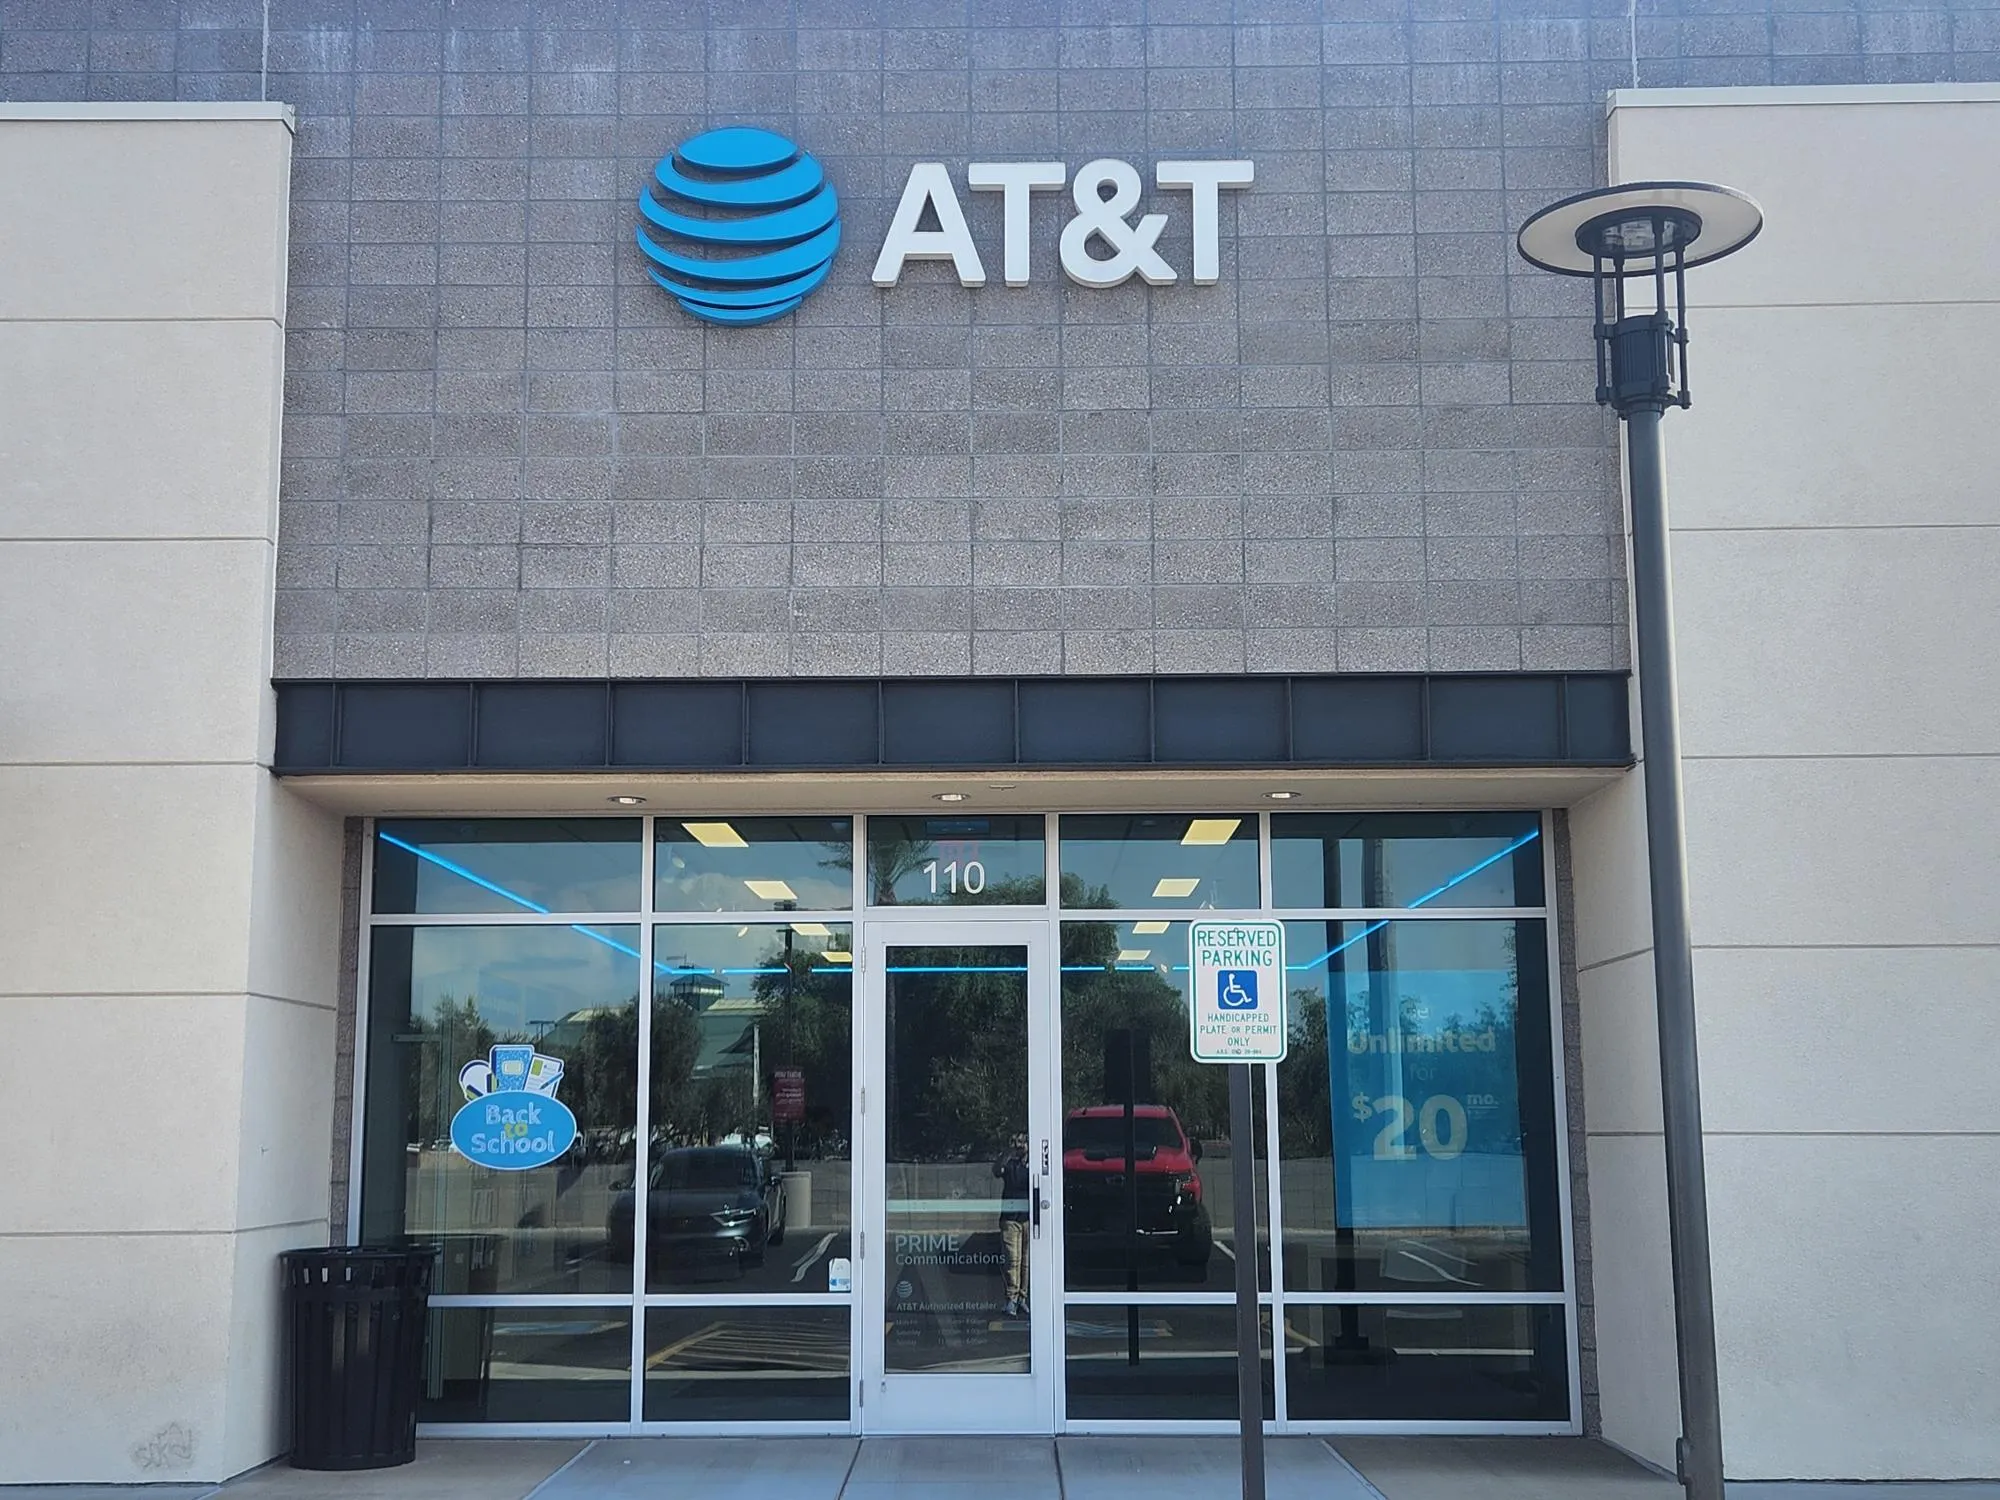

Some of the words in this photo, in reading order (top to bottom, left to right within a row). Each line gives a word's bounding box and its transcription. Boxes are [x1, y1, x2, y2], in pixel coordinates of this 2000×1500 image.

[871, 158, 1255, 288] AT&T
[923, 860, 985, 895] 110
[1197, 929, 1276, 947] RESERVED
[1202, 949, 1273, 967] PARKING
[1207, 1013, 1269, 1023] HANDICAPPED
[1199, 1025, 1227, 1034] PLATE
[1231, 1025, 1240, 1034] OR
[1245, 1025, 1277, 1034] PERMIT
[1227, 1037, 1250, 1047] ONLY
[1346, 1027, 1496, 1054] Unlimited
[1409, 1066, 1436, 1081] for
[485, 1101, 542, 1125] Back
[503, 1120, 529, 1139] to
[1351, 1091, 1468, 1162] $20
[471, 1130, 556, 1155] School
[895, 1234, 960, 1253] PRIME
[895, 1252, 1006, 1266] Communications
[896, 1302, 918, 1311] AT&T
[919, 1301, 964, 1311] Authorized
[965, 1300, 998, 1311] Retailer
